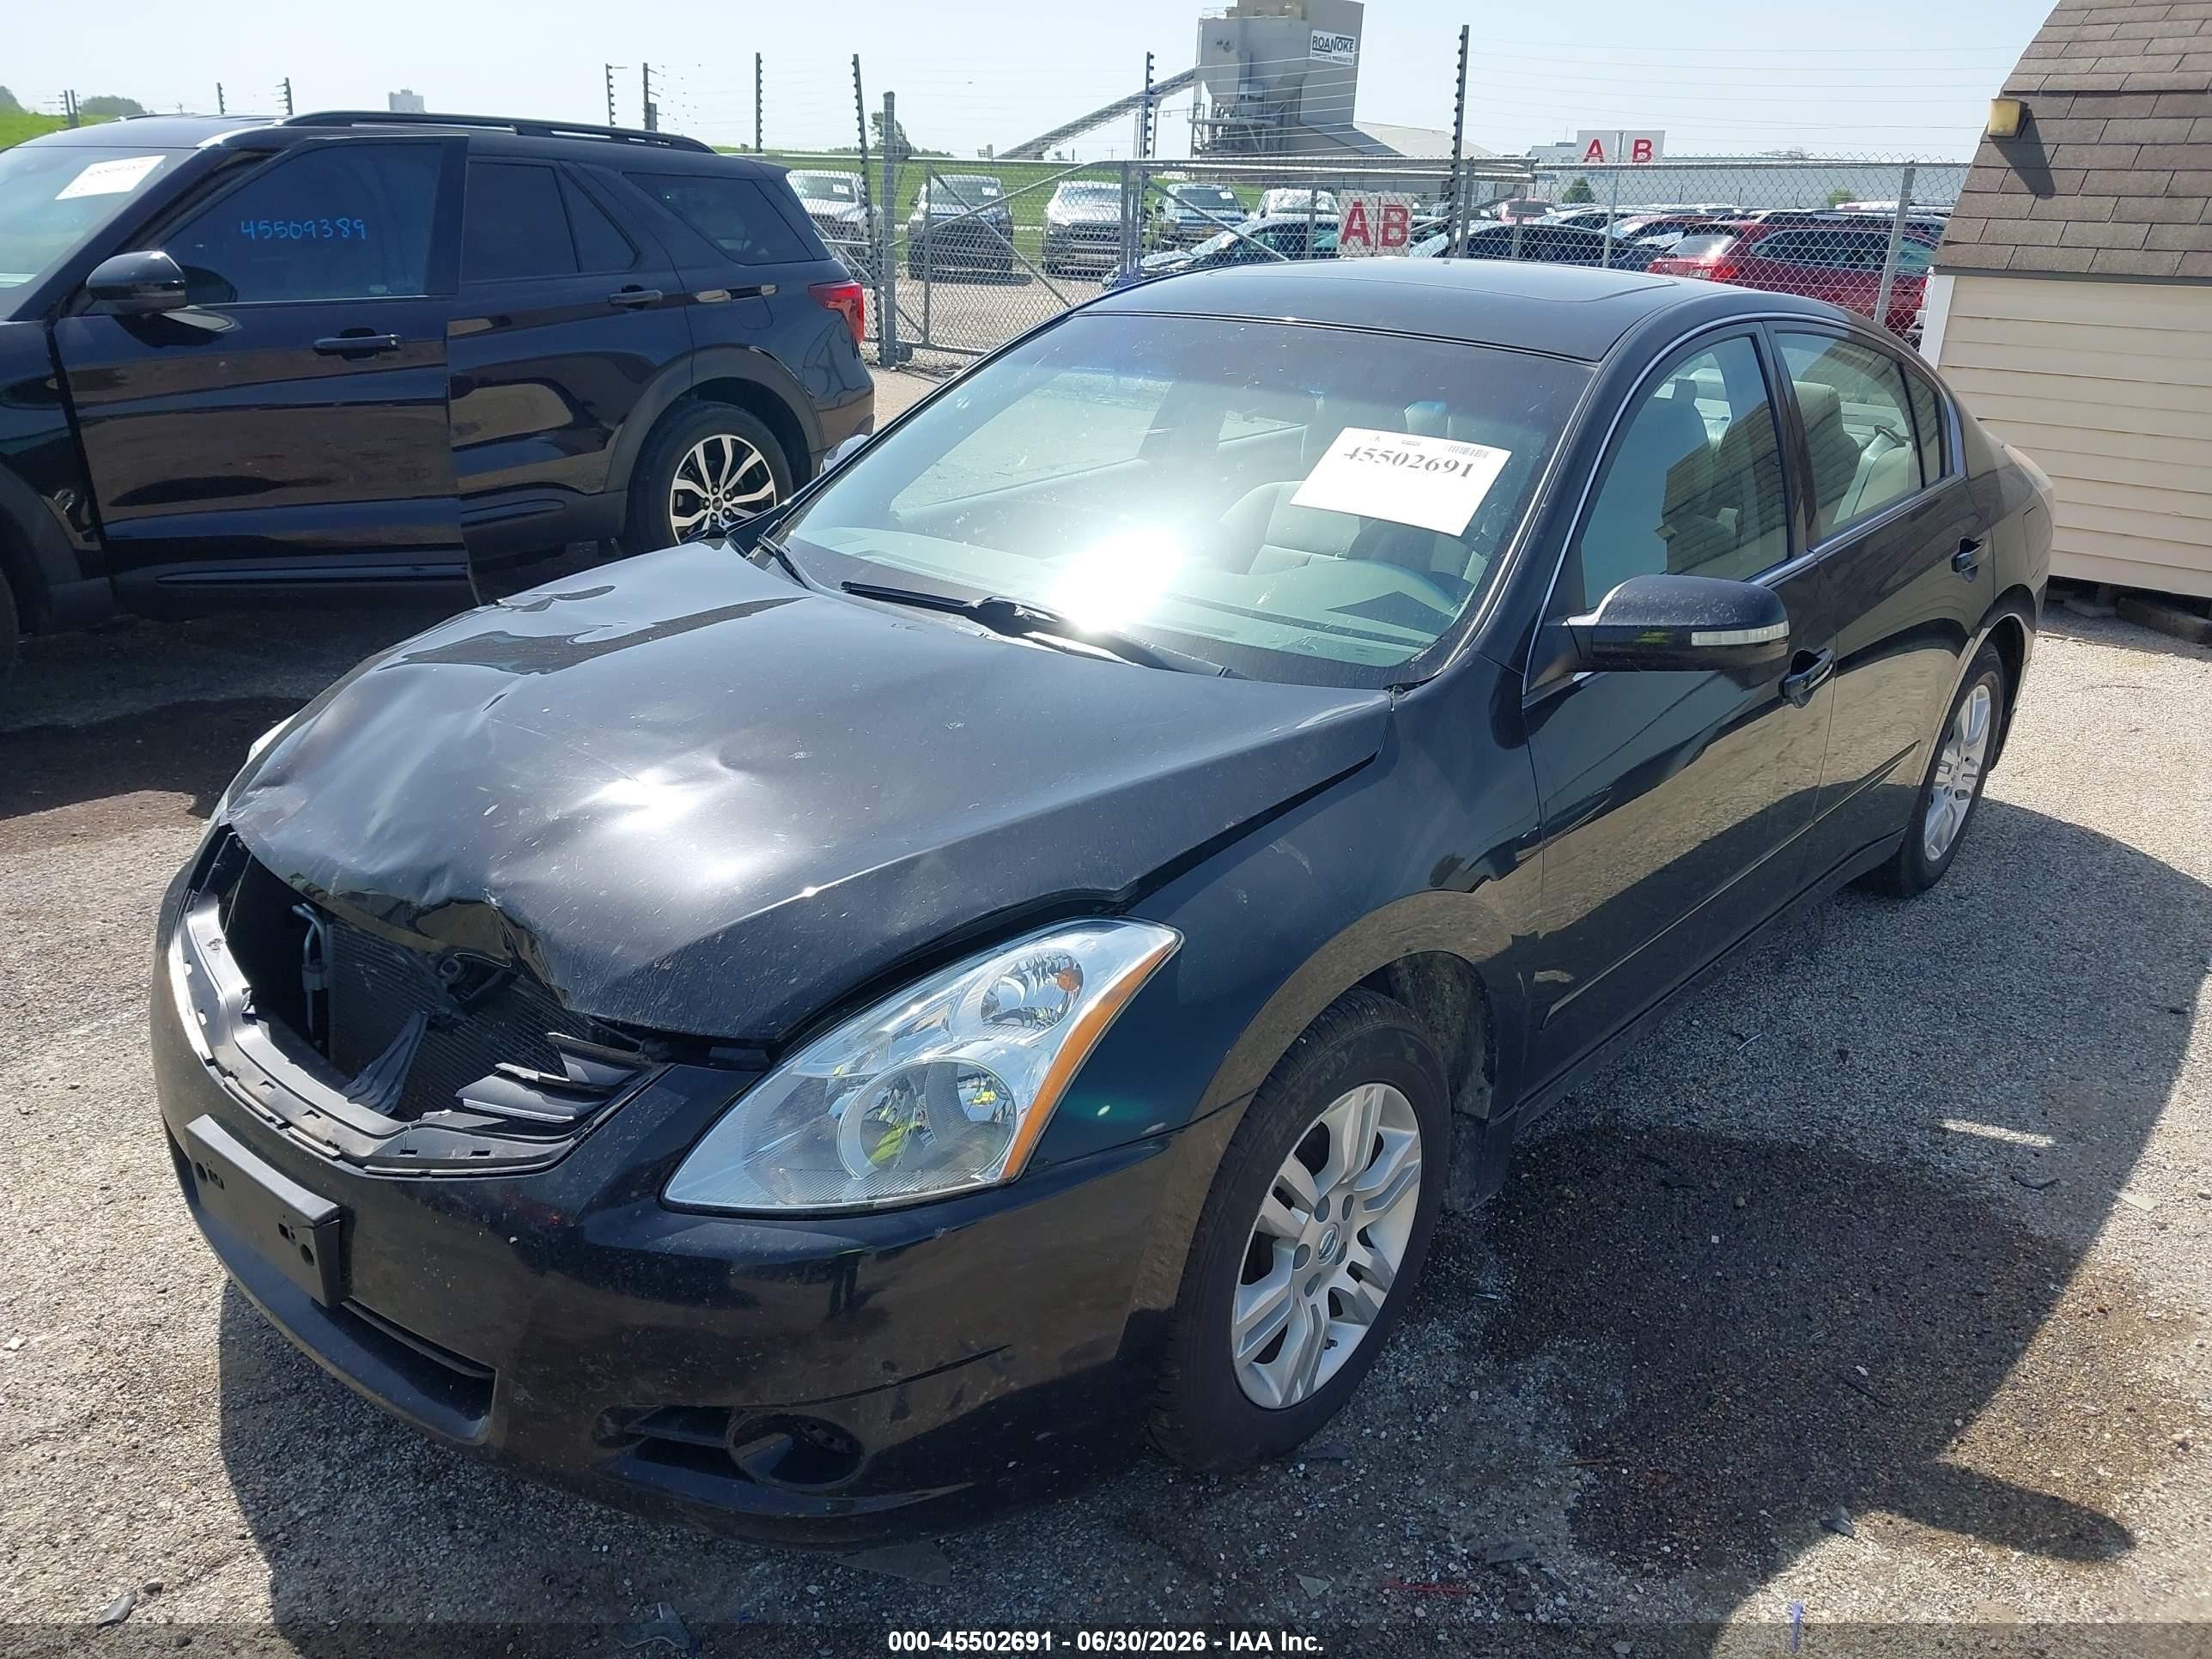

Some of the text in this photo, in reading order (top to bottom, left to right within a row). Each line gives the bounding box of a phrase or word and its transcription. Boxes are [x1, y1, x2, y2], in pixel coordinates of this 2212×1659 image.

[1312, 35, 1354, 53] ROANOKE
[240, 217, 366, 240] 45509389
[1343, 446, 1474, 477] 45502691
